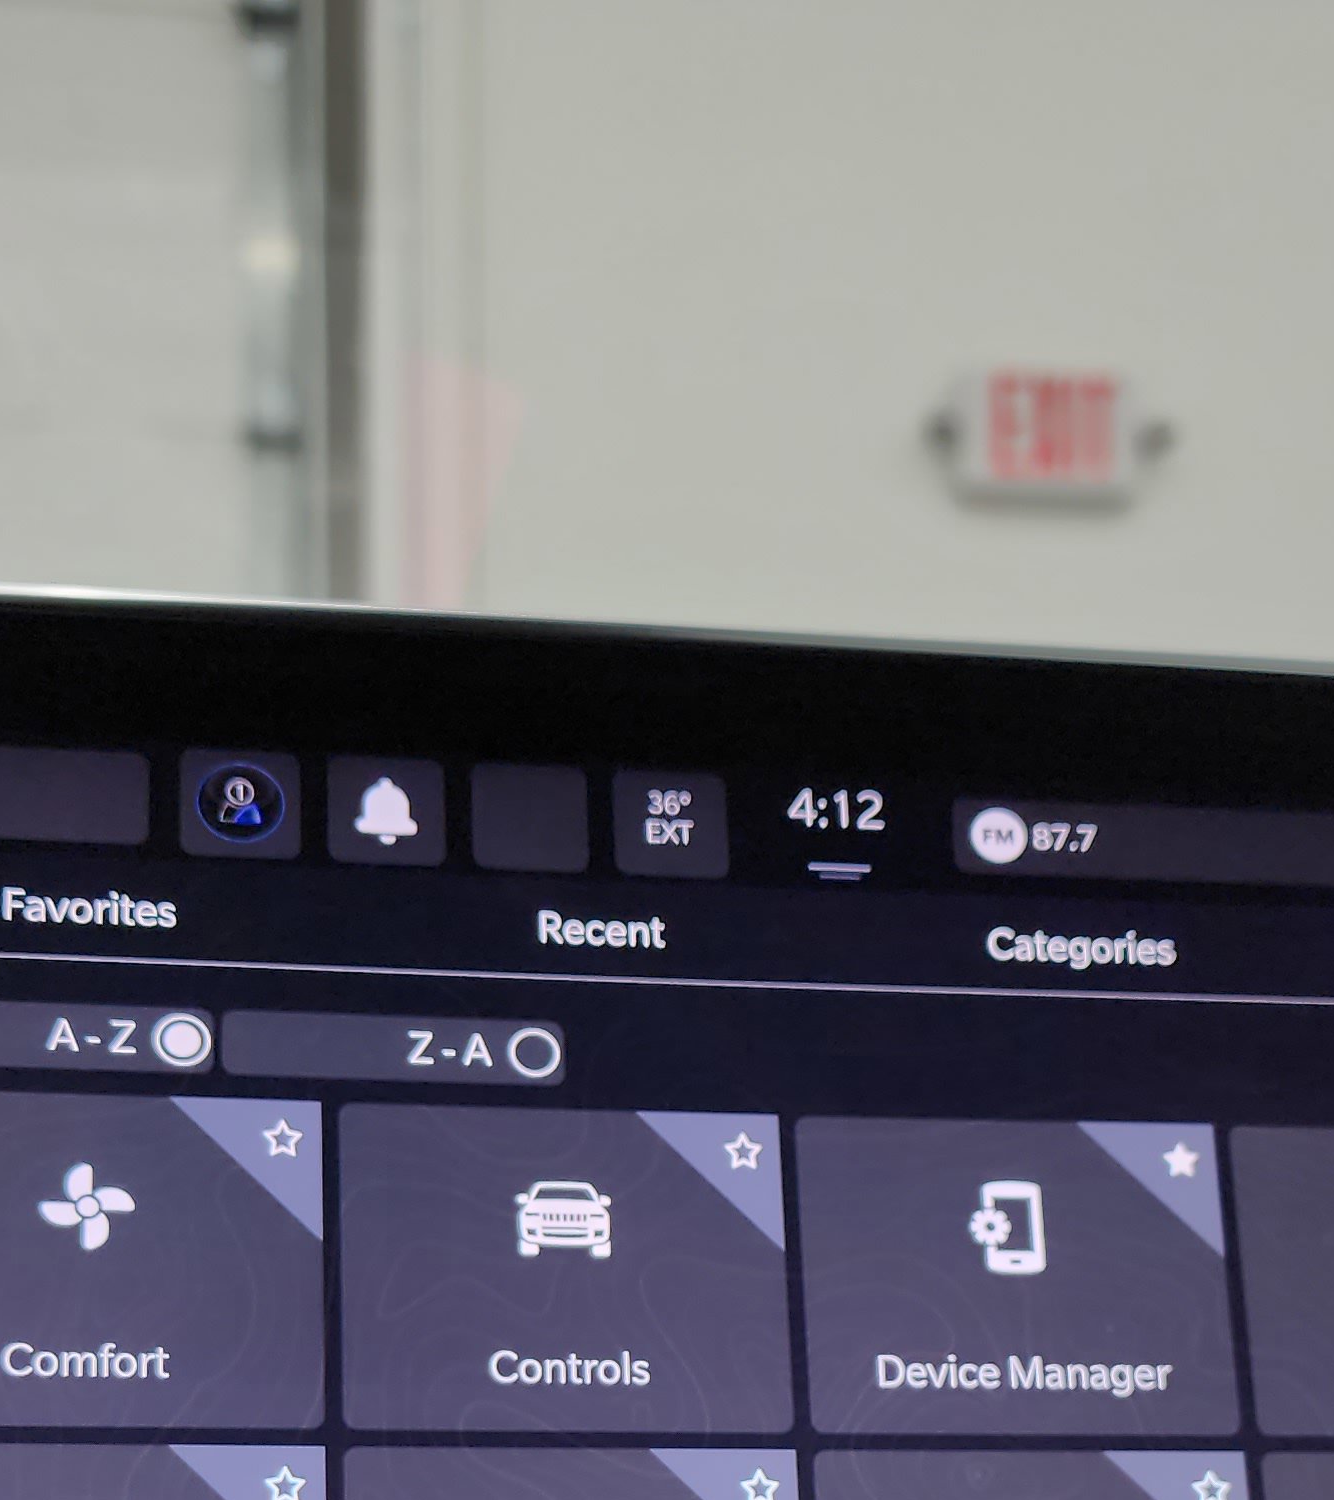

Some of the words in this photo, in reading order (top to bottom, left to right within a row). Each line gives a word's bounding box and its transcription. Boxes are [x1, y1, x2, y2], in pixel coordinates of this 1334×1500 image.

[787, 788, 885, 831] 4:12
[645, 817, 695, 846] EXT
[981, 827, 1015, 846] FM
[1032, 821, 1099, 853] 87.7
[0, 886, 177, 928] Favorites
[537, 909, 667, 949] Recent
[986, 926, 1178, 970] Categories
[0, 1342, 170, 1381] Comfort
[488, 1349, 651, 1387] Controls
[875, 1353, 999, 1391] Device
[1008, 1355, 1173, 1401] Manager
